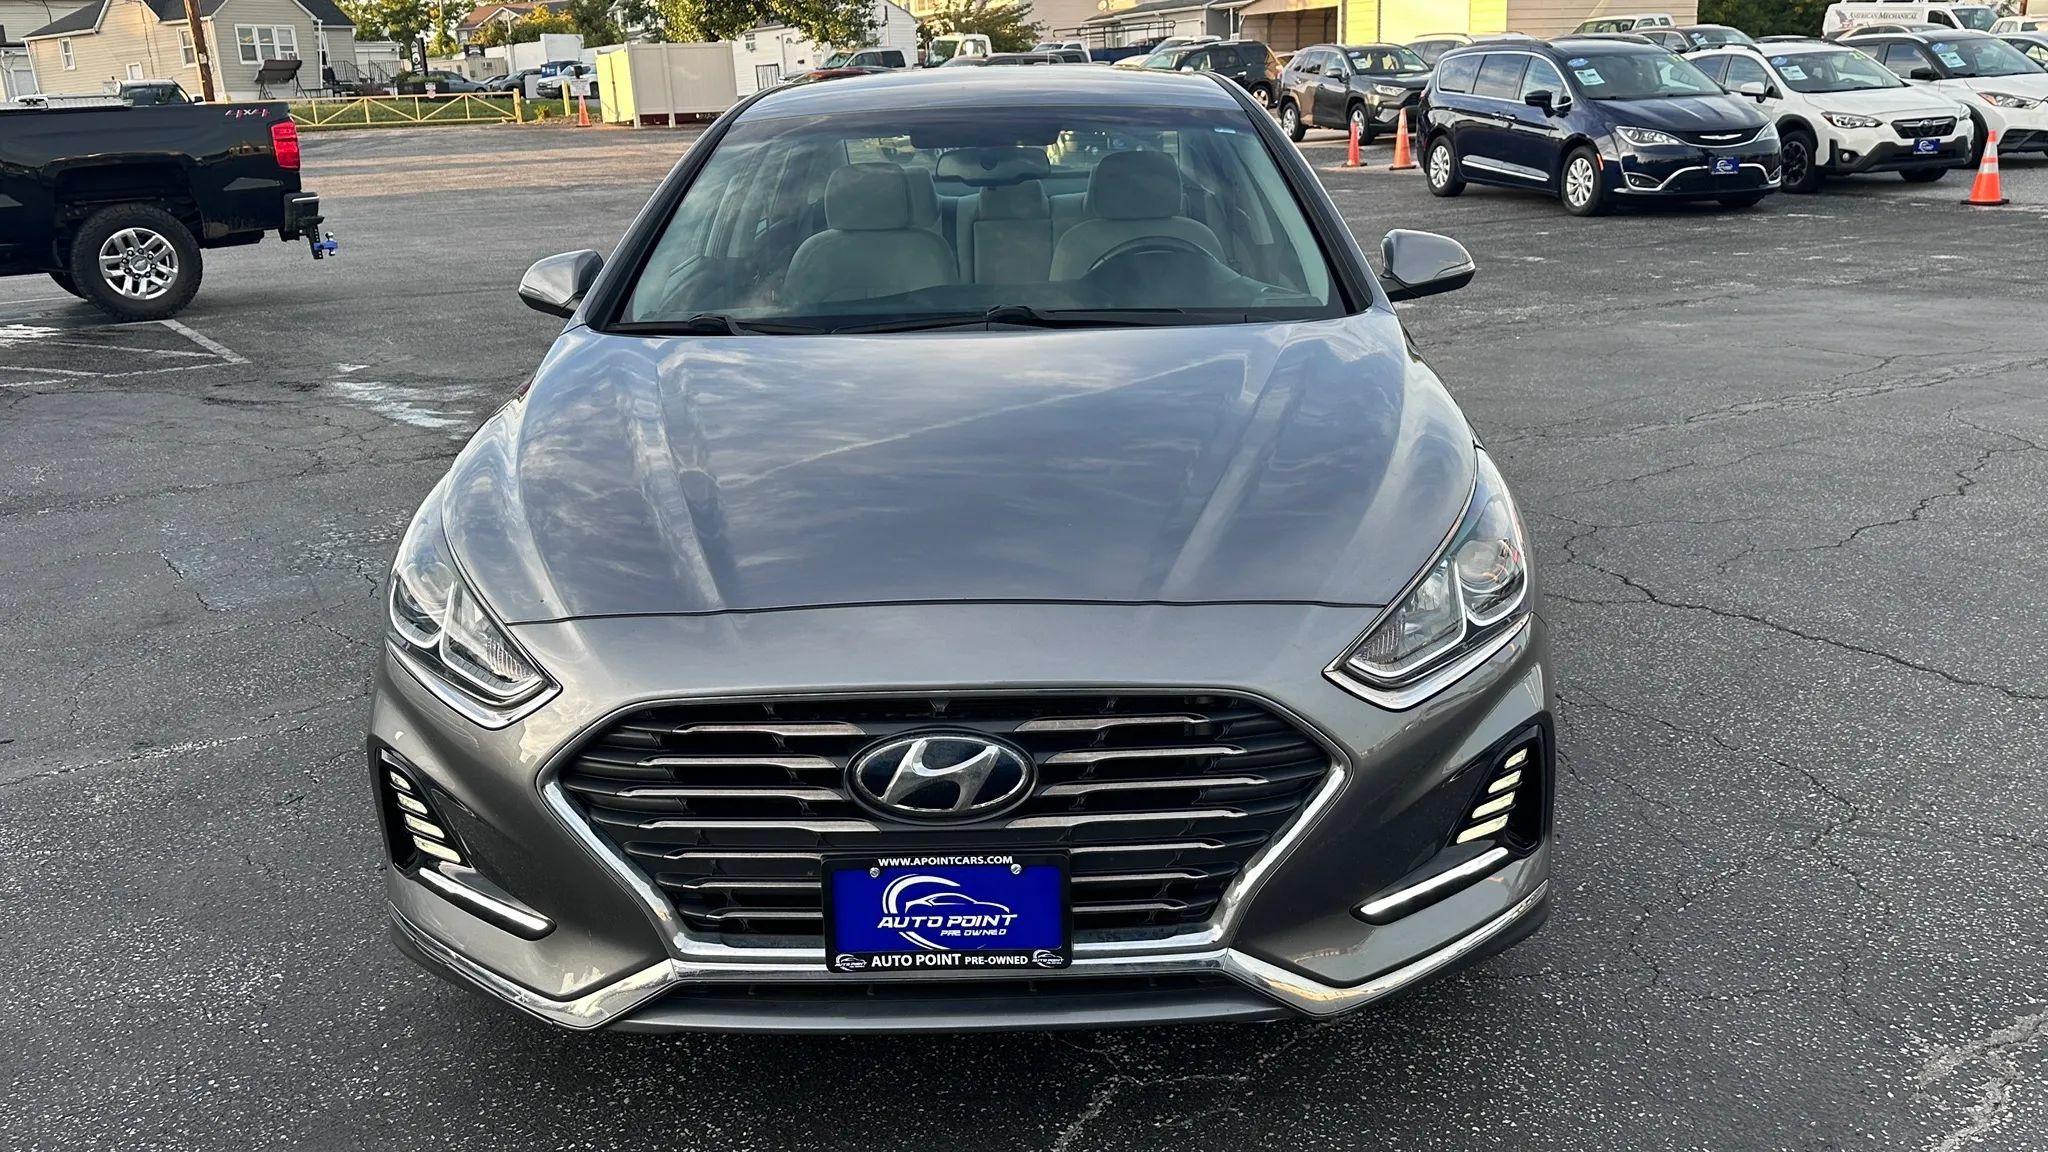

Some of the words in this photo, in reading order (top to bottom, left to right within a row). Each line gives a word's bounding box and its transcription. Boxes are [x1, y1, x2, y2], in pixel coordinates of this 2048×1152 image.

[1878, 12, 1918, 20] MECHANICAL
[878, 855, 1013, 867] WWW.APOINTCARS.COM
[877, 916, 943, 928] AUTO
[947, 914, 1018, 928] POINT
[964, 928, 1007, 936] OWNED
[871, 955, 914, 967] AUTO
[916, 953, 961, 966] POINT
[965, 956, 1028, 965] PRE-OWNED
